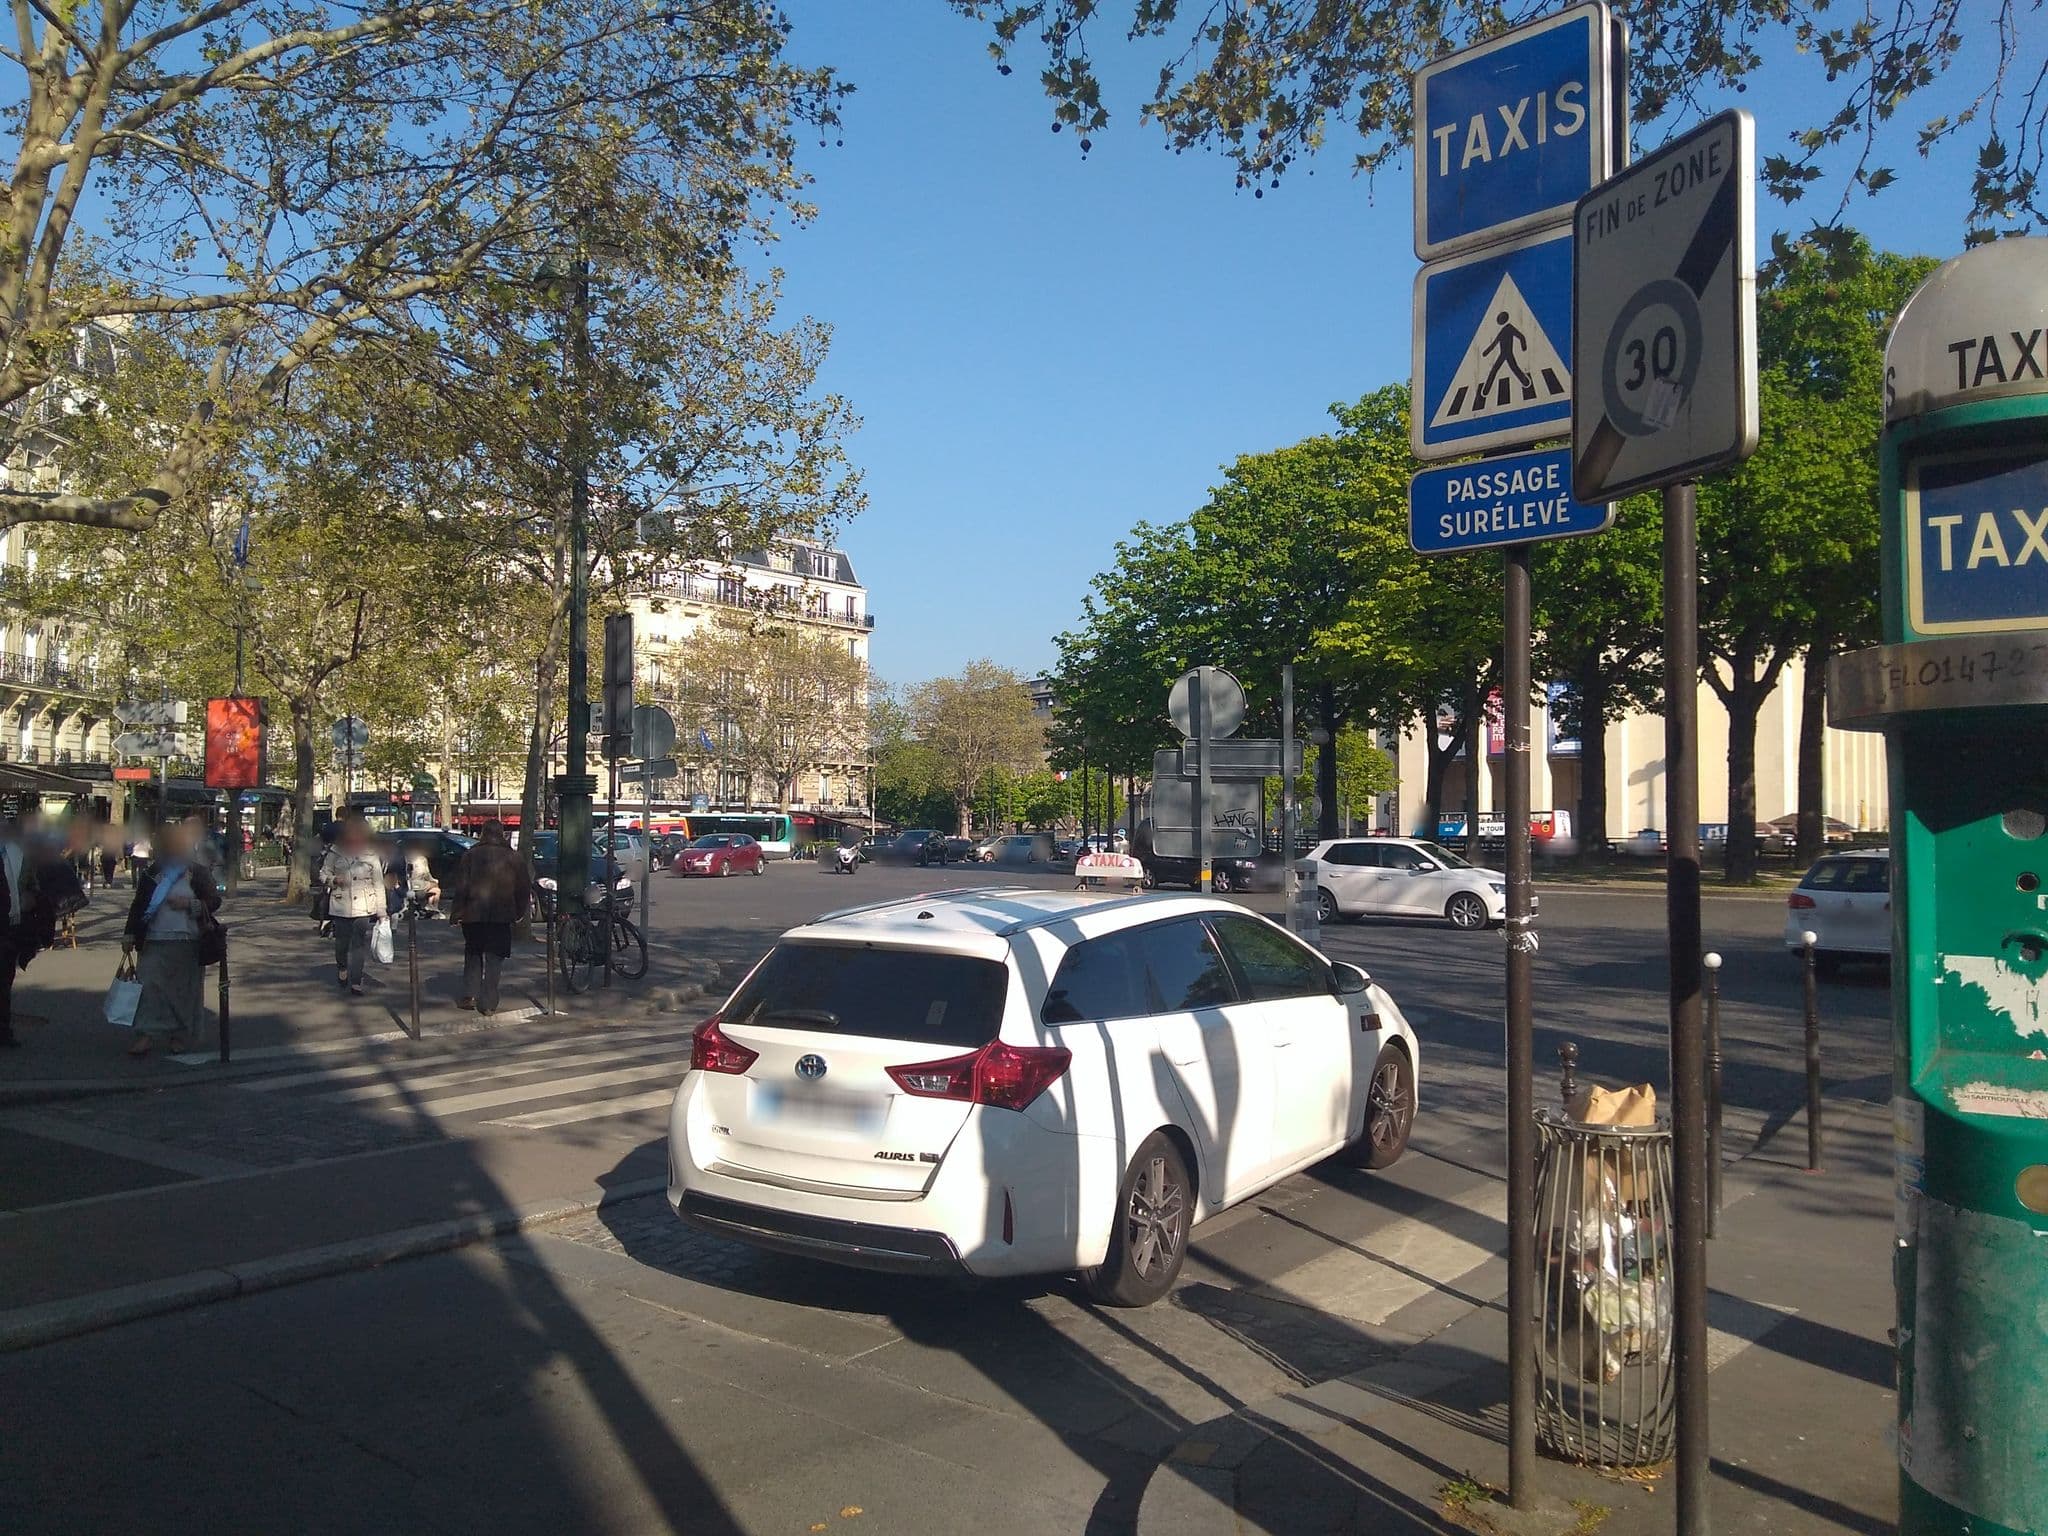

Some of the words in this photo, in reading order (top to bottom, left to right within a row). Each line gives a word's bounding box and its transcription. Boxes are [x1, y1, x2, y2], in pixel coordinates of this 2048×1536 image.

[1432, 81, 1586, 177] TAXIS
[1586, 198, 1620, 245] FIN
[1627, 194, 1646, 223] DE
[1654, 140, 1722, 207] ZONE
[1624, 326, 1677, 391] 30
[1447, 463, 1561, 503] PASSAGE
[1439, 491, 1570, 539] SURÉLEVÉ
[1093, 854, 1120, 867] TAXI
[874, 1151, 915, 1161] AURIS
